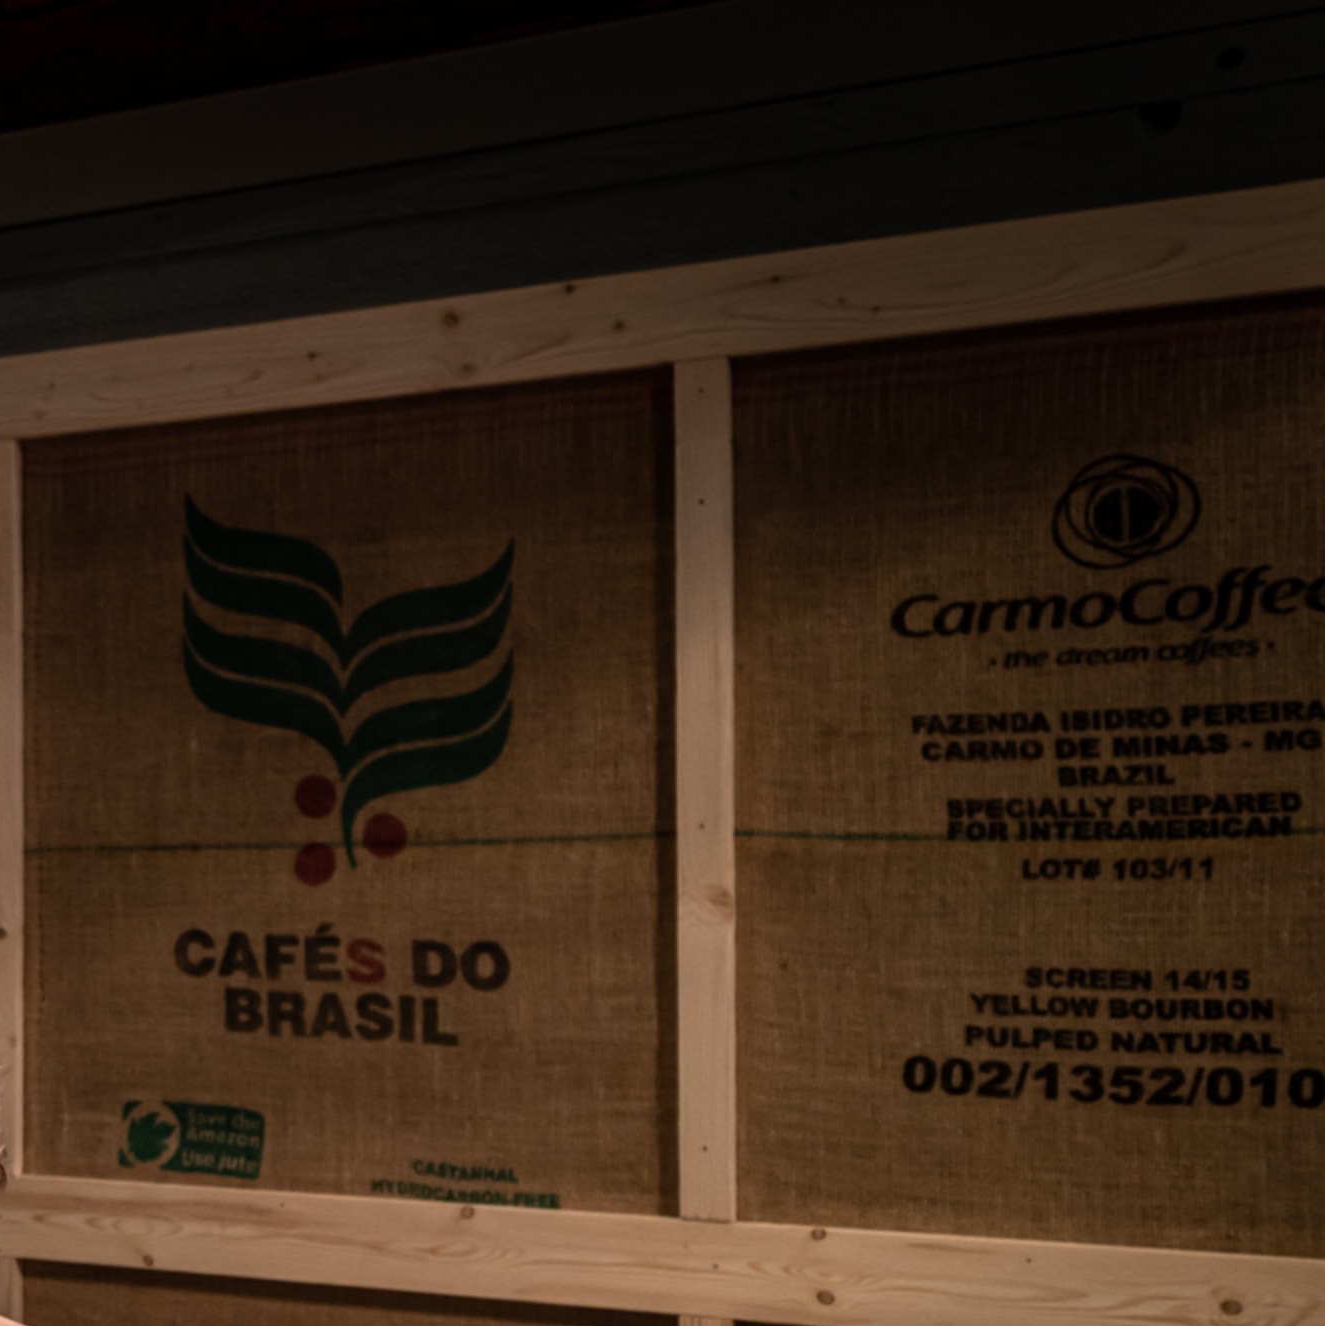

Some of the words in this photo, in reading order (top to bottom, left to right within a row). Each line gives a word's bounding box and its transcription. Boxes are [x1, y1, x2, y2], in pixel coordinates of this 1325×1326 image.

[1055, 645, 1150, 667] dream
[1156, 637, 1260, 665] coffees
[911, 711, 1051, 736] FAZENDA
[1060, 708, 1172, 733] ISIDRO
[1181, 700, 1325, 727] PEREIRA
[921, 738, 1043, 762] CARMO
[1055, 737, 1100, 760] DE
[1113, 733, 1228, 759] MINAS
[1264, 728, 1322, 752] MG
[1058, 764, 1175, 788] BRAZIL
[947, 797, 1116, 820] SPECIALLY
[1128, 791, 1302, 818] PREPARED
[947, 820, 1008, 842] FOR
[1019, 815, 1293, 842] INTERAMERICAN
[1022, 858, 1101, 881] LOT#
[1113, 856, 1214, 882] 103/11
[173, 923, 386, 984] CAFÉS
[411, 938, 511, 992] DO
[1025, 967, 1151, 992] SCREEN
[1165, 969, 1250, 992] 14/15
[223, 987, 459, 1046] BRASIL
[970, 994, 1097, 1017] YELLOW
[1109, 998, 1274, 1020] BOURBON
[964, 1025, 1098, 1051] PULPED
[1111, 1030, 1282, 1056] NATURAL
[185, 1126, 260, 1149] Amazon
